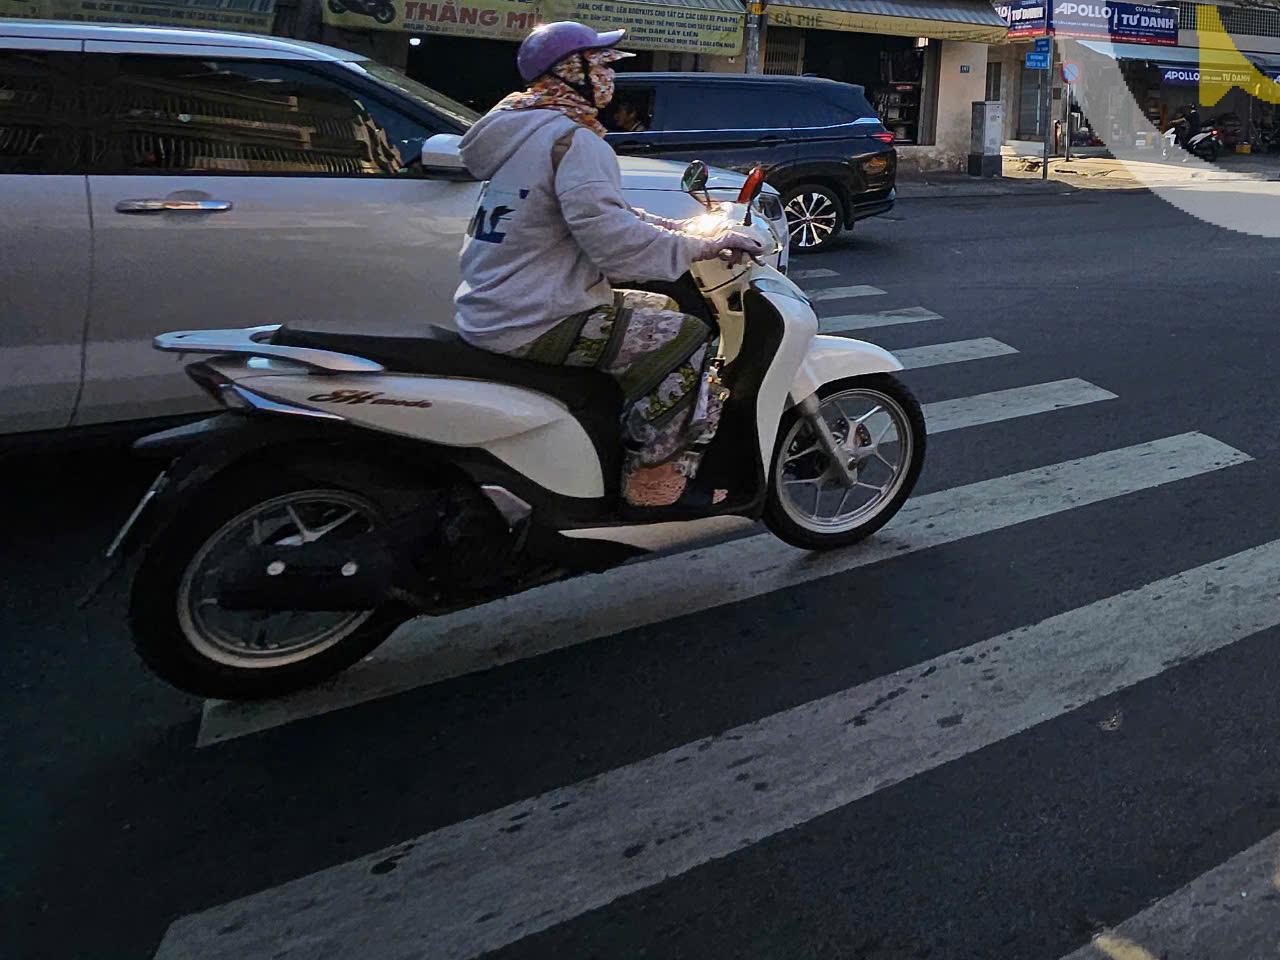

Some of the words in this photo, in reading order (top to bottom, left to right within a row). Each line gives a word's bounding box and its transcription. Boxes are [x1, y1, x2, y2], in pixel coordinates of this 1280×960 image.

[1054, 2, 1112, 19] APOLLO
[1121, 14, 1140, 26] TƯ
[1140, 16, 1174, 29] DANH
[1164, 71, 1200, 81] APOLLO
